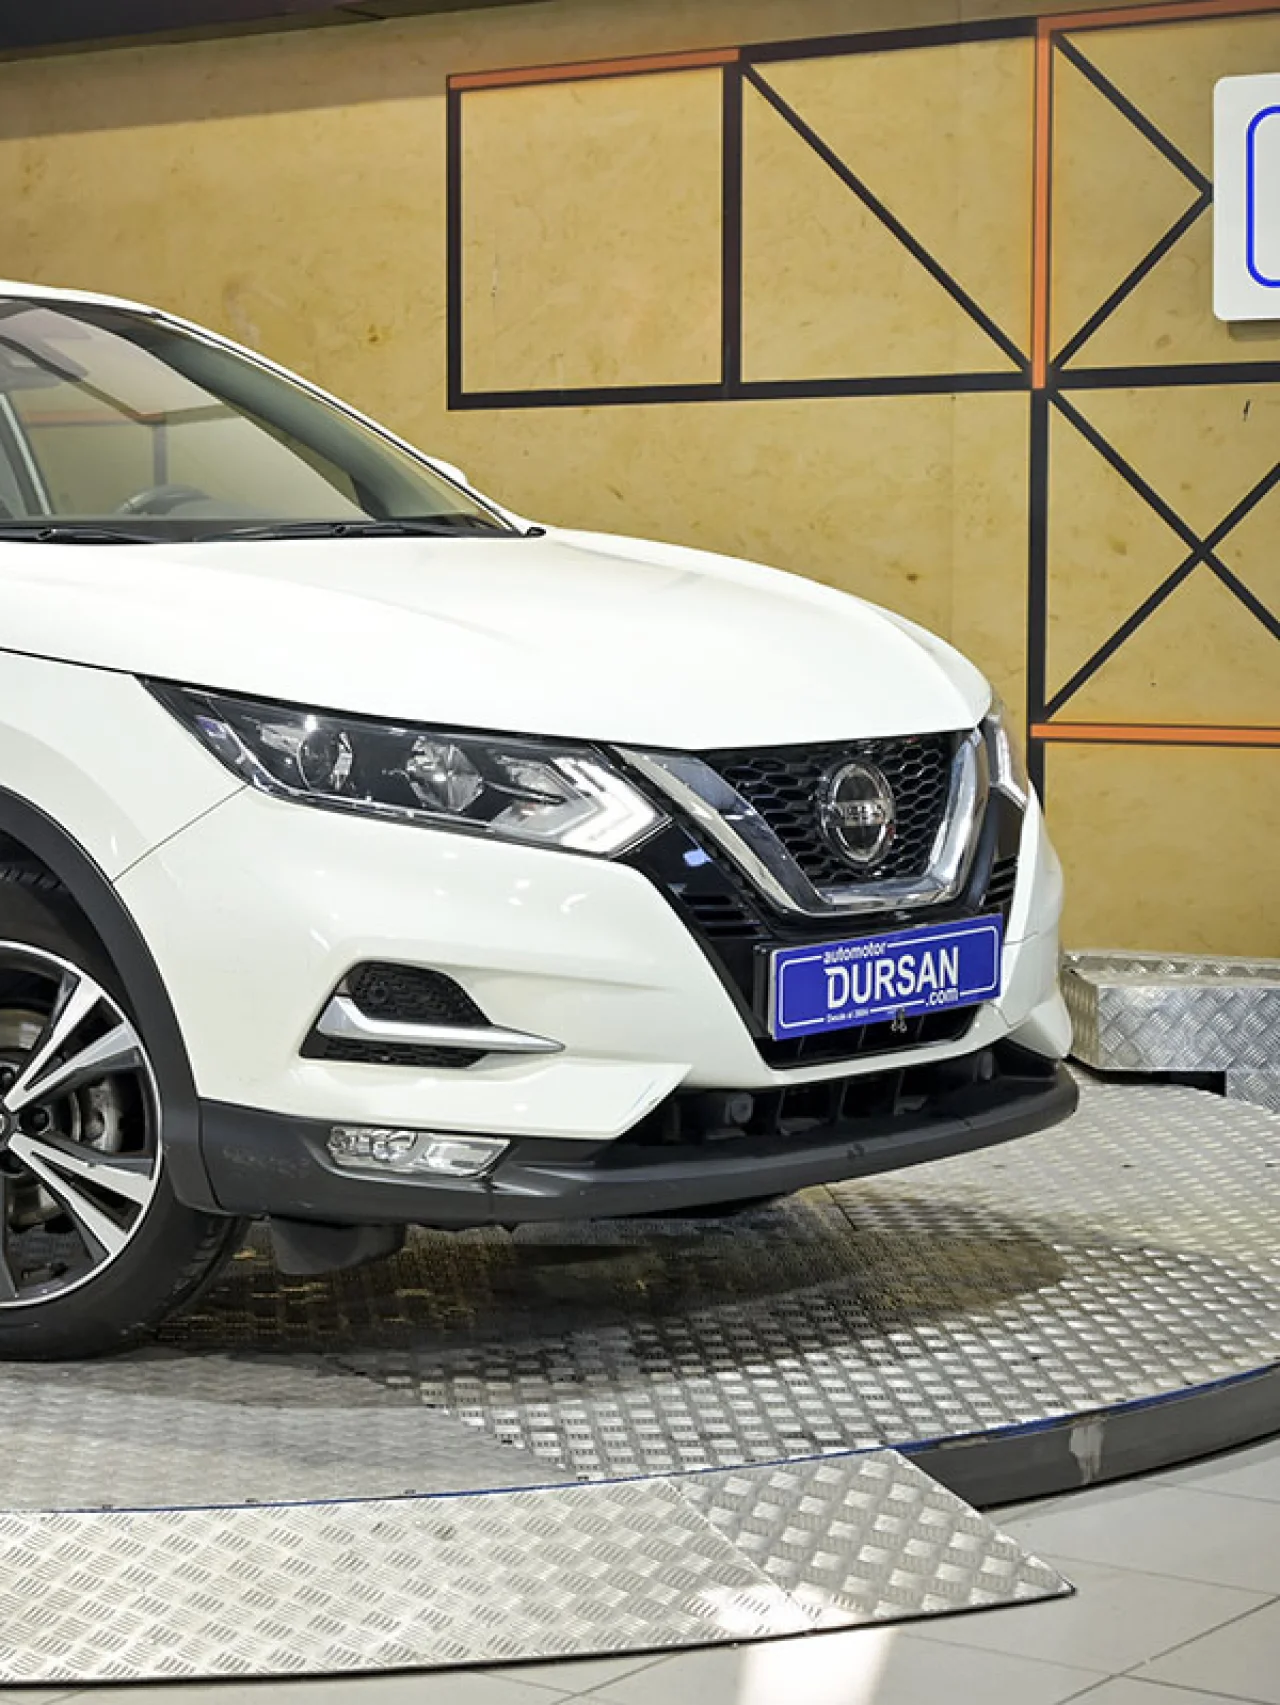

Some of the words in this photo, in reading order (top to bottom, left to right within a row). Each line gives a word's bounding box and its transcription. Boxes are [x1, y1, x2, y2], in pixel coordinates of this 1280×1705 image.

[824, 942, 886, 964] automotor
[825, 947, 958, 1008] DURSAN
[925, 989, 958, 1007] .com
